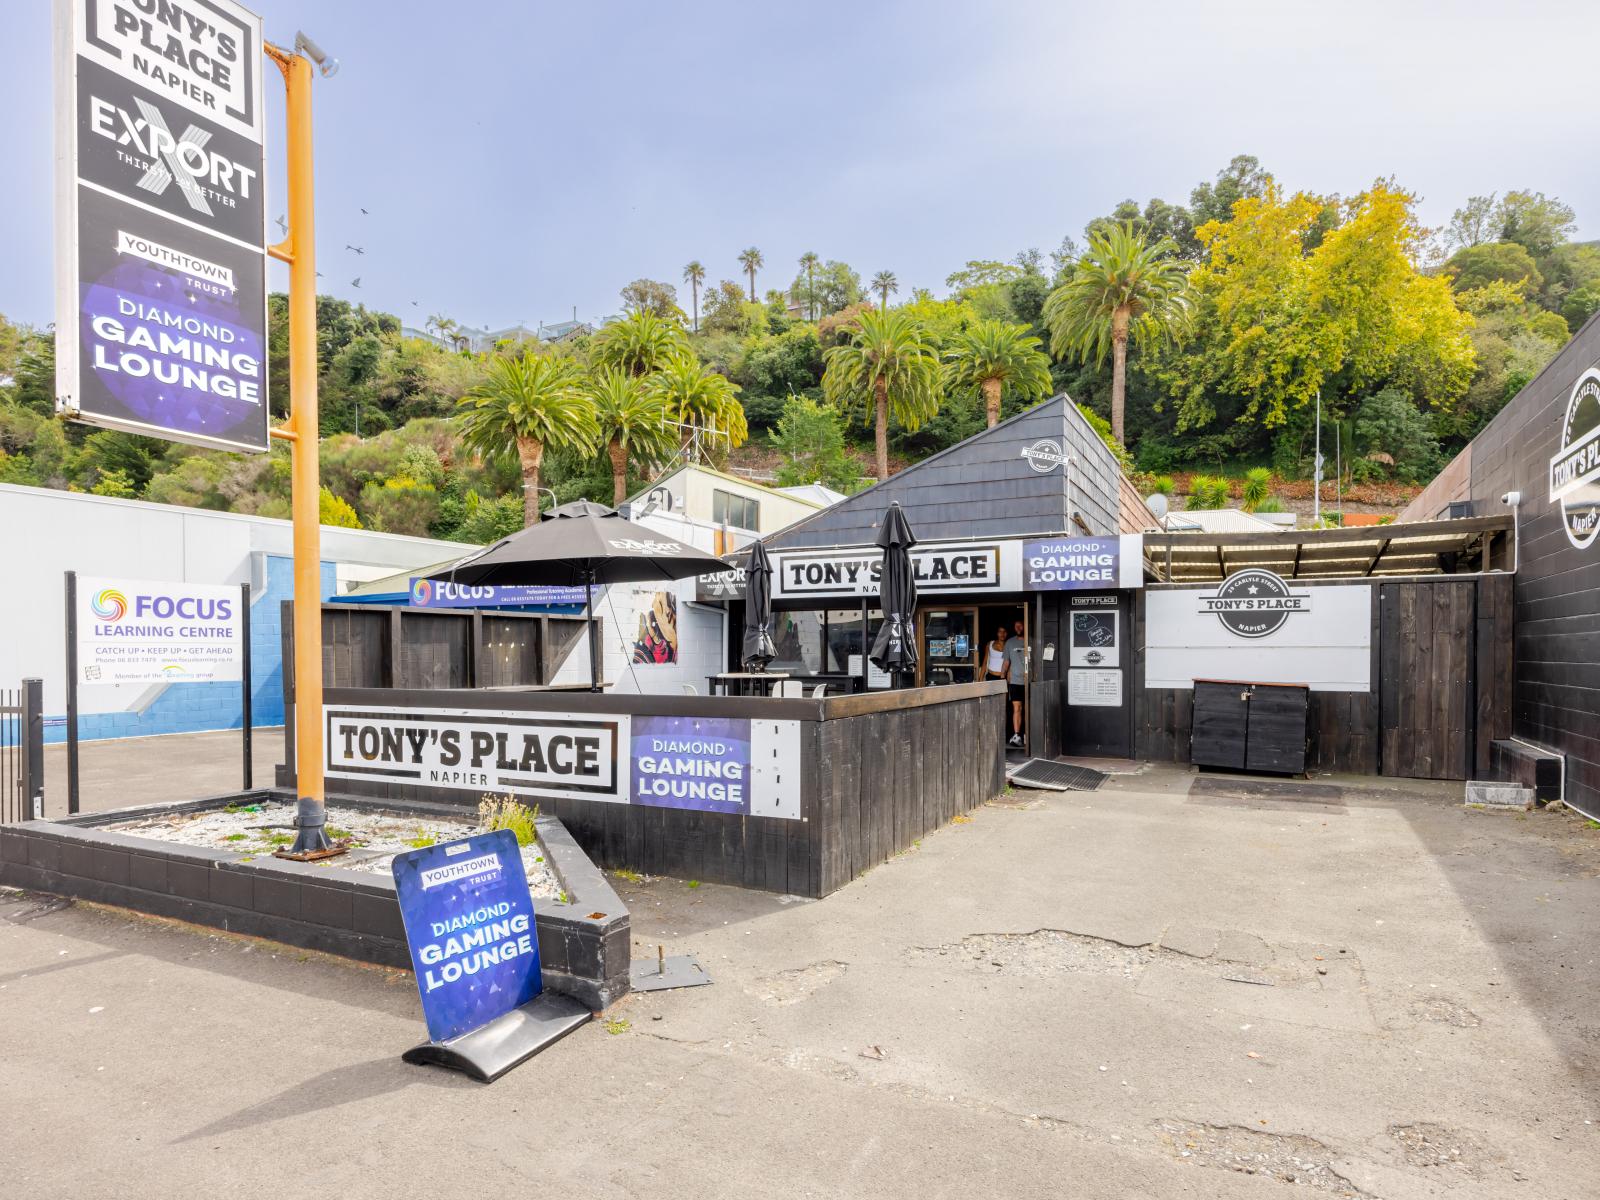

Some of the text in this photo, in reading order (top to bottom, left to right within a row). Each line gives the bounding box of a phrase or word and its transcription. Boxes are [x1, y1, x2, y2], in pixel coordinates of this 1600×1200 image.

[131, 0, 237, 62] NY'S
[114, 4, 231, 92] PLACE
[133, 53, 216, 110] NAPIER
[91, 95, 256, 199] EXPORT
[117, 150, 173, 181] THIRSTY
[195, 184, 236, 209] BETTER
[125, 236, 228, 281] YOUTHTOWN
[186, 278, 226, 296] TRUST
[119, 298, 234, 344] DIAMOND
[92, 316, 259, 377] GAMING
[95, 345, 259, 403] LOUNGE
[1554, 448, 1587, 489] TONY'S
[1572, 507, 1597, 533] NAPIER
[1030, 554, 1113, 568] GAMING
[1042, 543, 1100, 554] DIAMOND
[699, 568, 746, 583] EXPOR
[790, 555, 988, 584] TONY'S LACE
[1030, 568, 1113, 583] LOUNGE
[435, 582, 495, 600] FOCUS
[1234, 577, 1260, 587] CARLYLE
[1260, 578, 1279, 593] STREET
[135, 596, 232, 621] FOCUS
[1207, 599, 1301, 610] TONY'S PLACE
[95, 625, 233, 638] LEARNING CENTRE
[1238, 623, 1267, 631] NAPIER
[95, 647, 233, 655] CATCH UP KEEP UP GET AHEAD
[339, 724, 600, 776] TONY'S PLACE
[653, 740, 726, 756] DIAMOND
[430, 770, 488, 786] NAPIER
[638, 757, 743, 780] GAMING
[639, 778, 743, 802] LOUNGE
[426, 857, 496, 883] YOUTHTOWN
[469, 872, 497, 885] TRUST
[433, 902, 510, 938] DIAMOND
[420, 914, 530, 965] GAMING
[425, 935, 532, 991] LOUNGE
